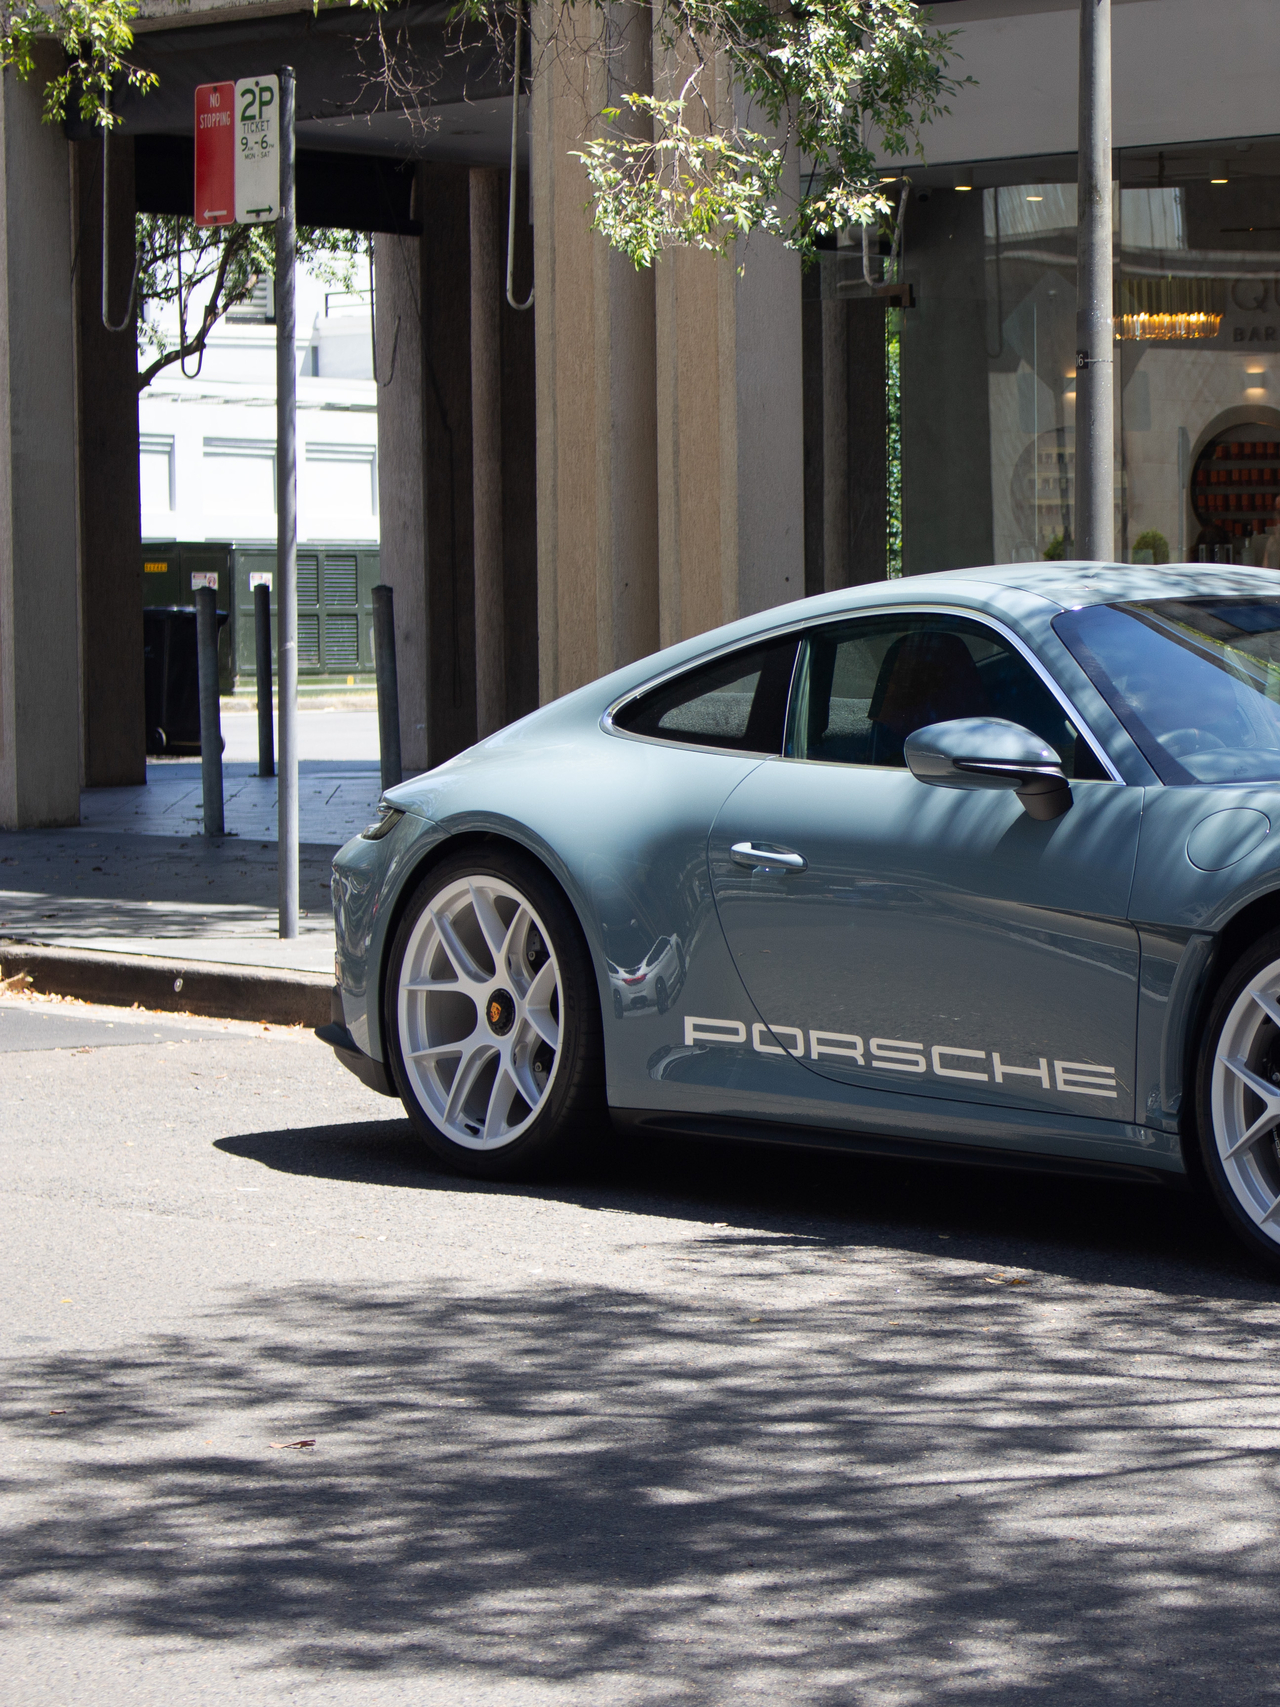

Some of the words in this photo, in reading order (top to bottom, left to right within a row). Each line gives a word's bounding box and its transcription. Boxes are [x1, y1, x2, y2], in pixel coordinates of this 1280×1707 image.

[209, 93, 221, 108] NO
[240, 86, 274, 121] 2P
[200, 112, 230, 129] STOPPING
[242, 120, 270, 134] TICKET
[244, 152, 256, 160] MON
[260, 151, 270, 159] SAT
[1232, 326, 1278, 342] BAR
[684, 1016, 1118, 1098] PORSCHE
